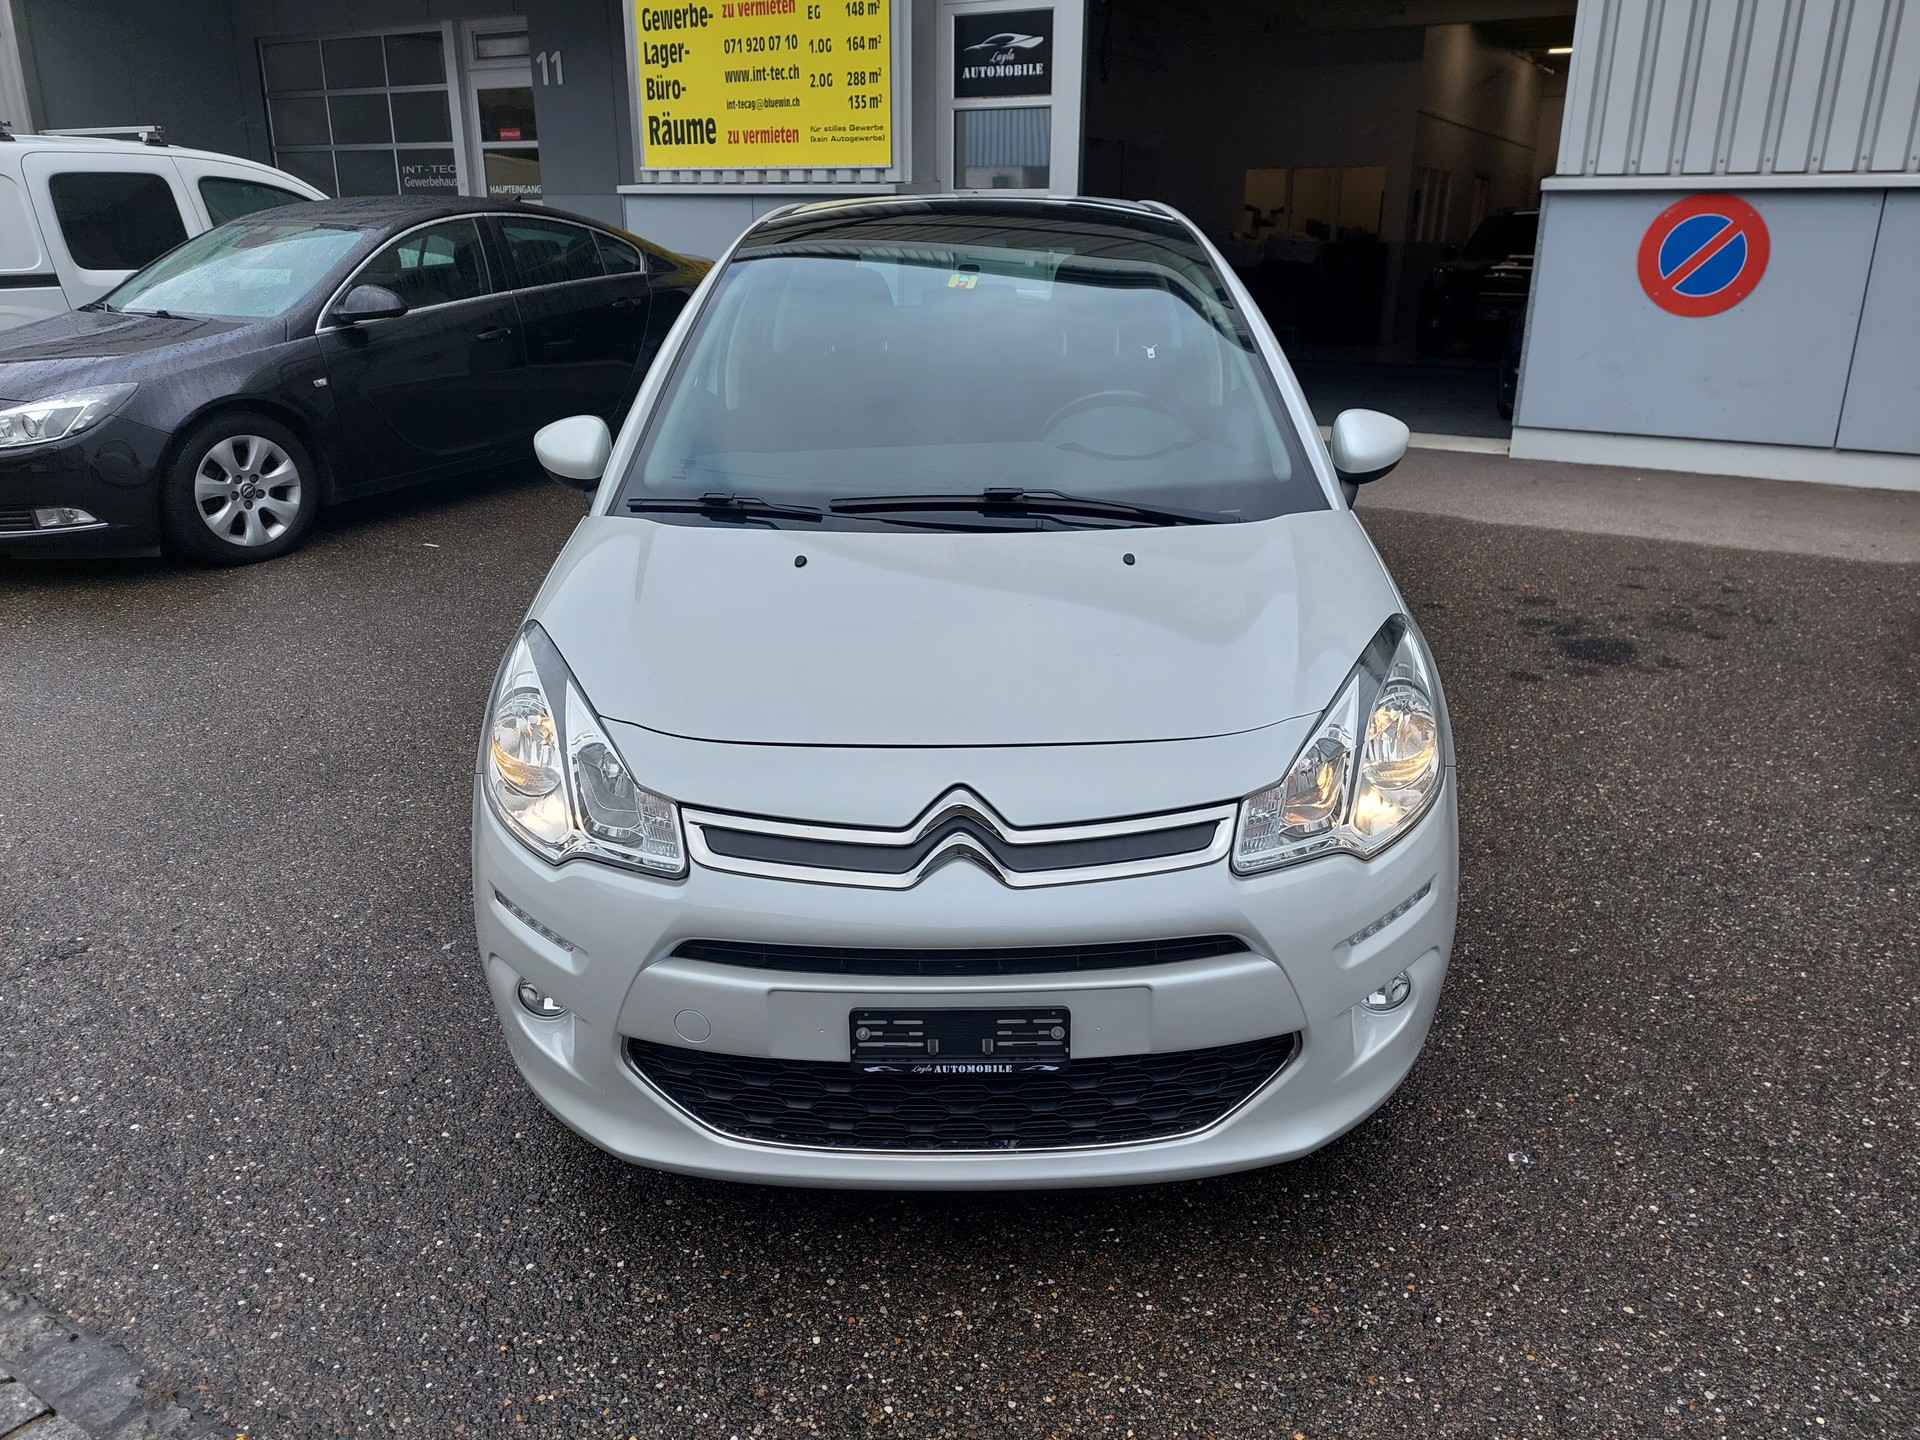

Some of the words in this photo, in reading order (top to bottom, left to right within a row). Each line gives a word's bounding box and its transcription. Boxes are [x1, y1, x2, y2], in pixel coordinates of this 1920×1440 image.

[642, 2, 714, 32] Gewerbe-
[722, 3, 735, 18] zu
[737, 0, 796, 17] vermieten
[807, 4, 821, 20] EG
[845, 1, 864, 17] 148
[723, 38, 743, 54] 071
[746, 36, 765, 53] 920
[768, 35, 781, 51] 07
[785, 34, 798, 50] 10
[846, 35, 866, 51] 164
[643, 41, 690, 69] Lager-
[535, 50, 564, 86] 11
[724, 64, 800, 84] www.int-tec.ch
[962, 63, 1044, 79] AUTOMOBILE
[846, 70, 867, 87] 288
[646, 74, 687, 101] Büro-
[726, 97, 800, 111] int-tecag@bluewin.ch
[848, 94, 867, 110] 135
[648, 111, 717, 146] Räume
[727, 130, 740, 144] zu
[742, 126, 799, 144] vermieten
[849, 124, 884, 132] Gewerbe
[810, 135, 828, 143] (kein
[830, 133, 886, 143] Autogewerbe)
[404, 176, 458, 187] Gewerbehaus
[489, 184, 542, 194] HAUPTEINGANG
[934, 1064, 1013, 1074] AUTOMOBILE
